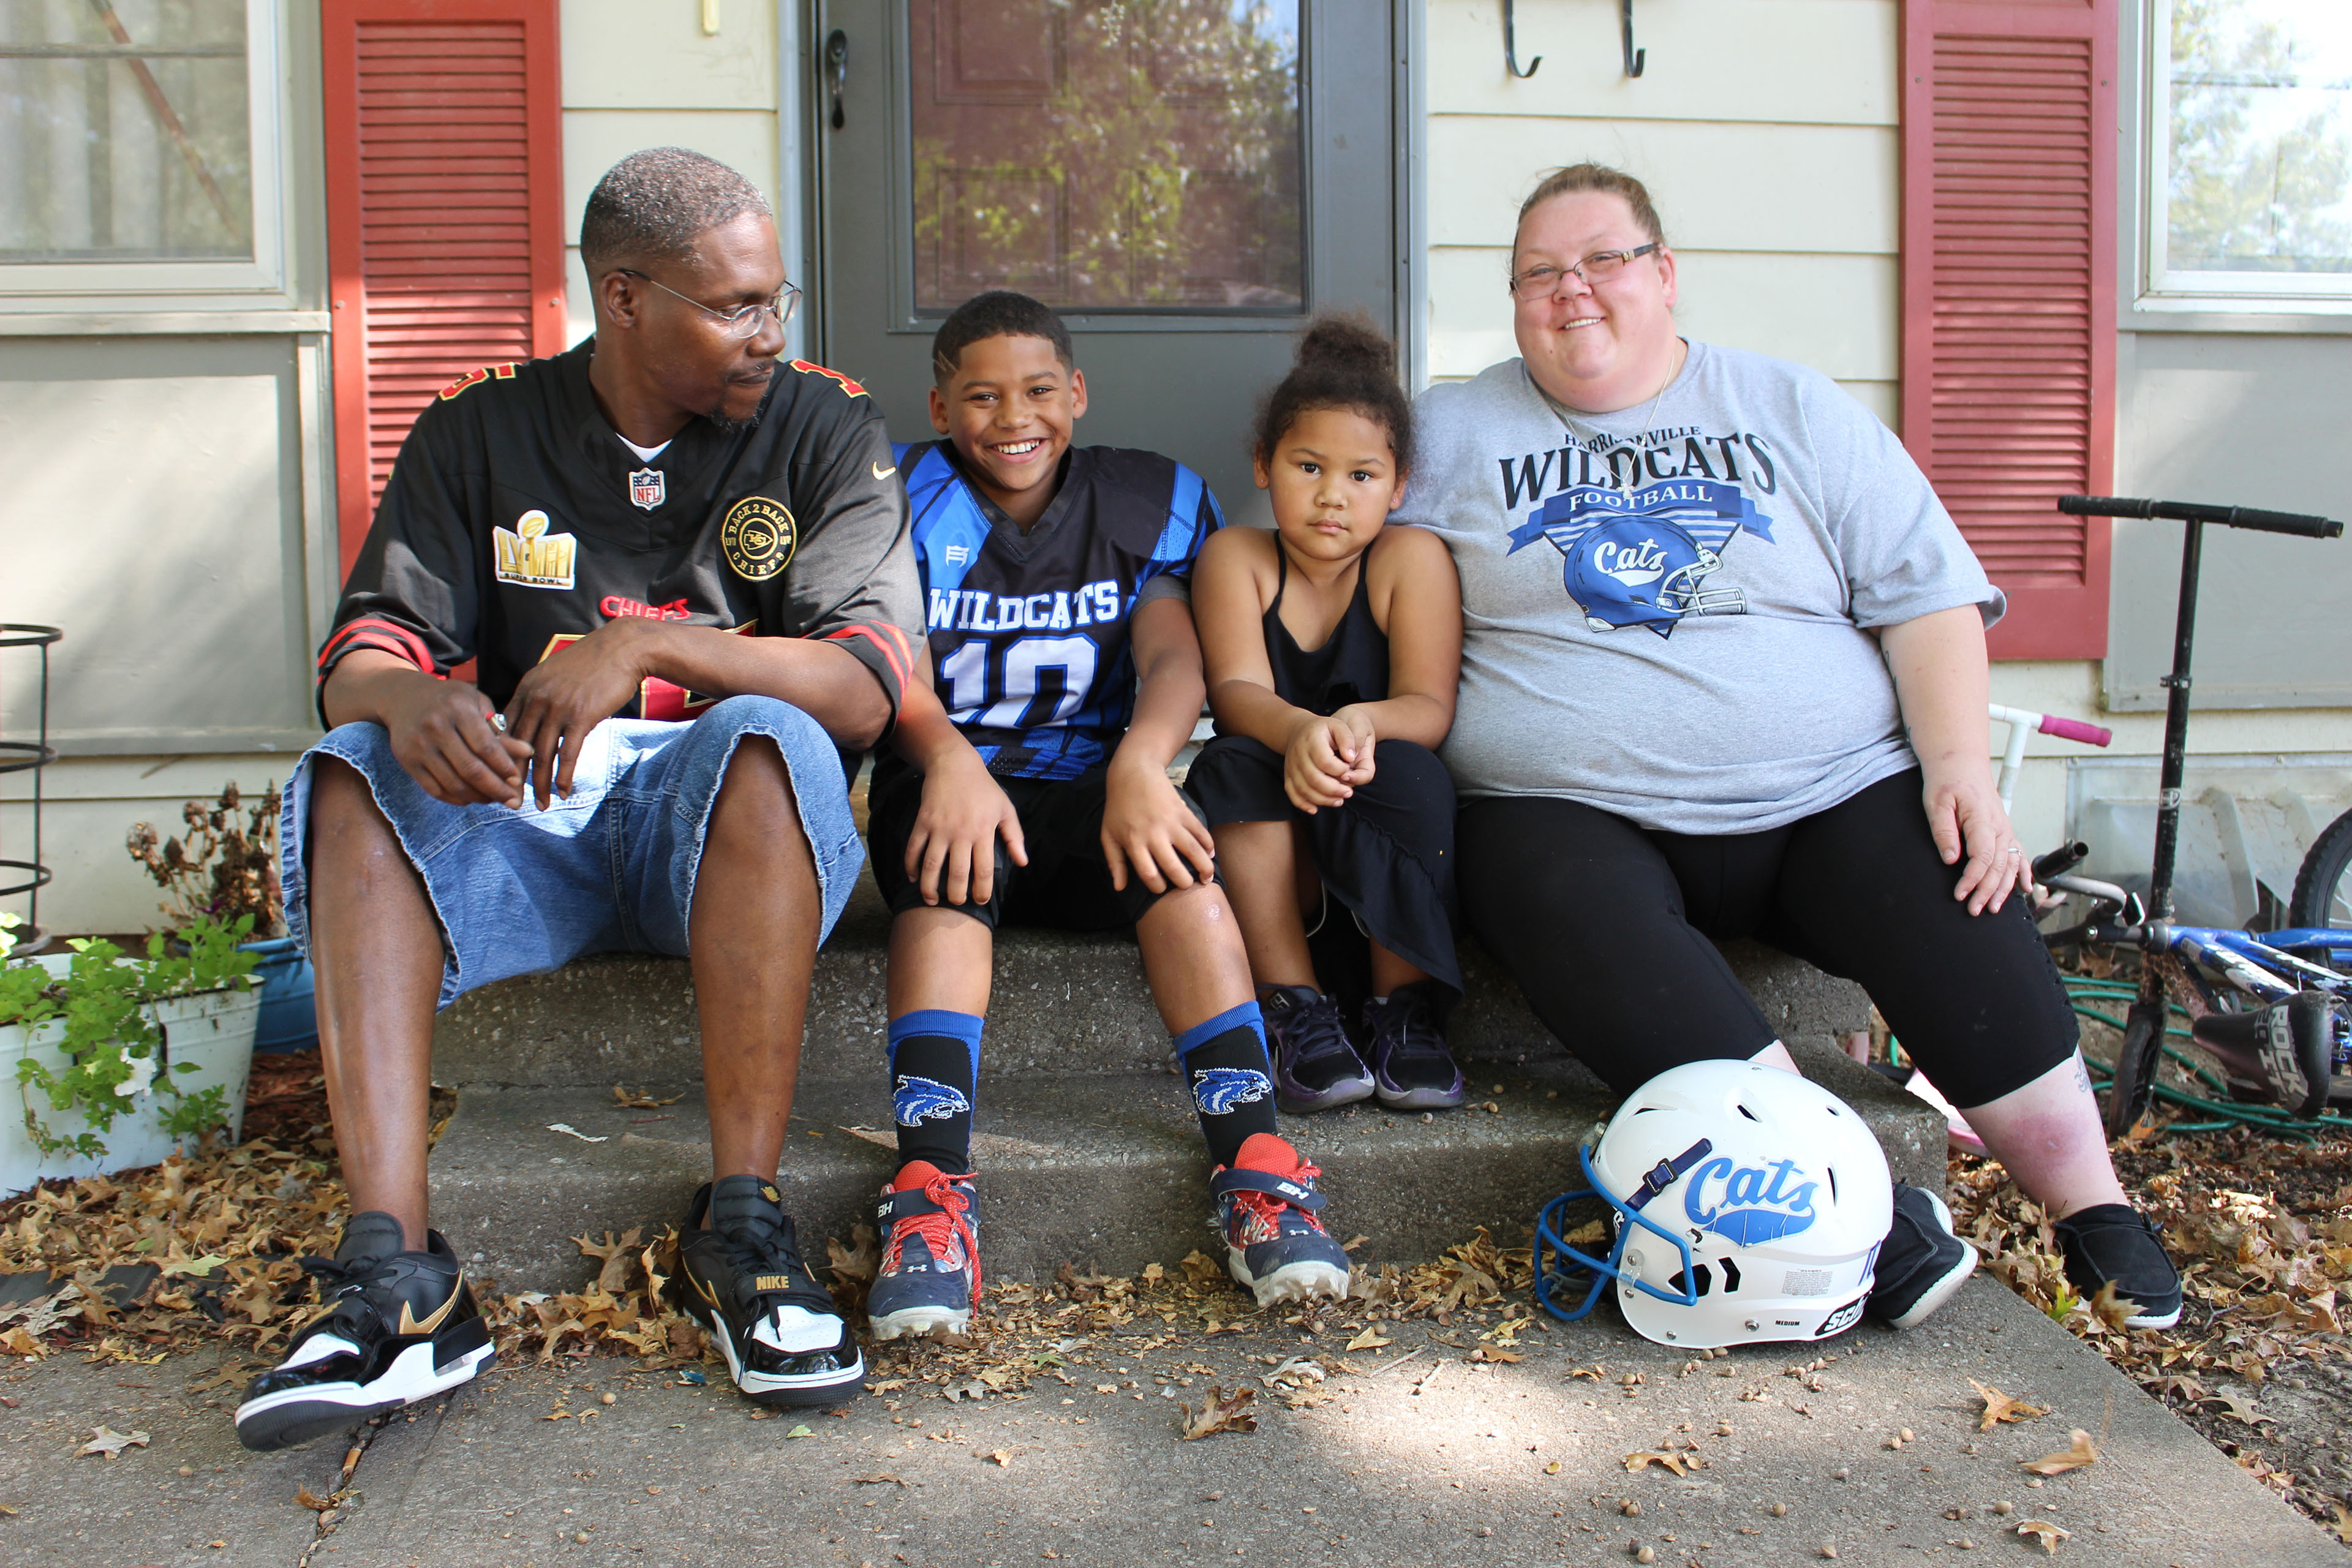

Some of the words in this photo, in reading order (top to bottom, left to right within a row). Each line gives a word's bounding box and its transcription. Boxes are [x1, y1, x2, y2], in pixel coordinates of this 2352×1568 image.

[1565, 426, 1701, 453] HARRINVILLE
[1498, 432, 1776, 510] WILDCATS
[636, 488, 660, 503] NFL
[1569, 484, 1713, 512] FOOTBALL
[733, 551, 785, 575] CHIEFS
[1594, 538, 1668, 575] Cats
[600, 595, 692, 622] CHIEFS
[927, 579, 1120, 633] WILDCATS
[940, 632, 1099, 728] 10
[2270, 1005, 2310, 1097] ROCK
[1276, 1181, 1310, 1200] BH
[1684, 1155, 1819, 1224] Cats
[877, 1200, 894, 1218] BH
[756, 1275, 790, 1291] NIKE
